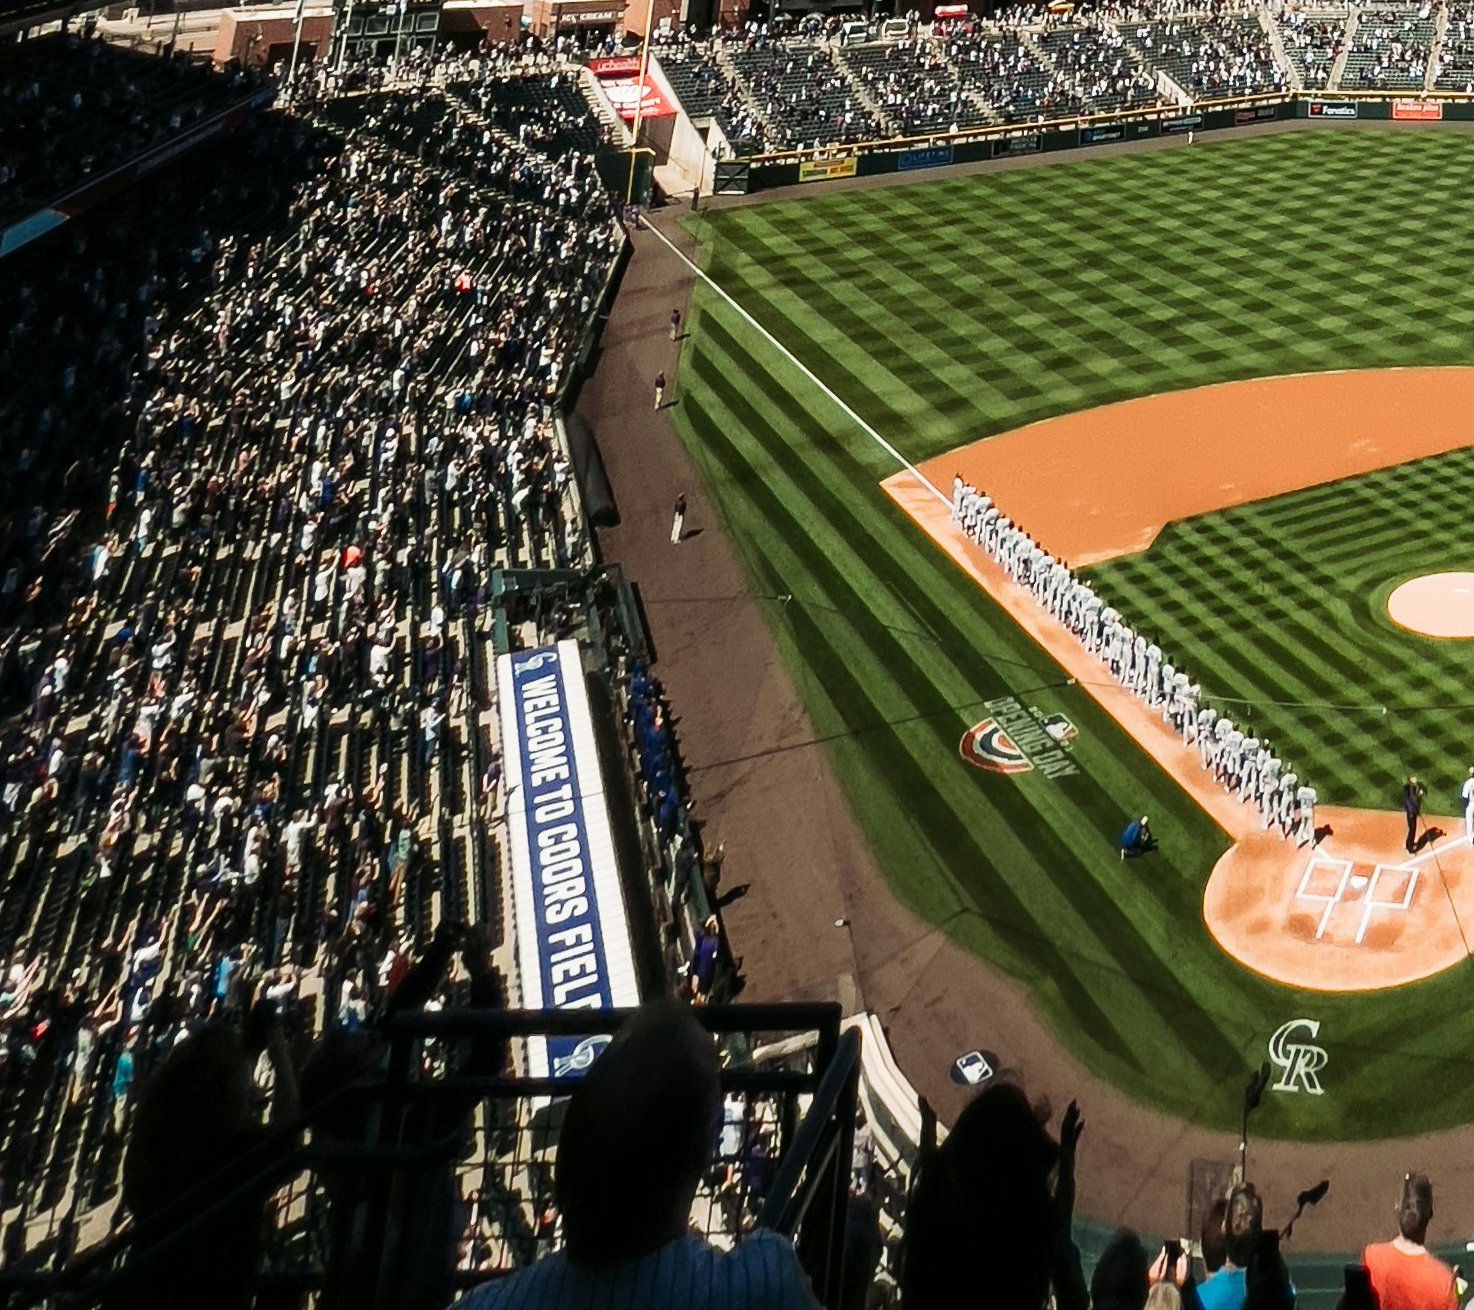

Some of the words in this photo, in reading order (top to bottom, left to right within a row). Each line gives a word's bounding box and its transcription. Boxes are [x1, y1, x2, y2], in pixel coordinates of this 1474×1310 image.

[1322, 105, 1356, 116] Fanatics
[521, 673, 571, 788] WELCOME
[984, 696, 1056, 755] OPENING
[1032, 749, 1081, 780] DAY
[533, 783, 575, 824] TO
[537, 822, 589, 924] COORS
